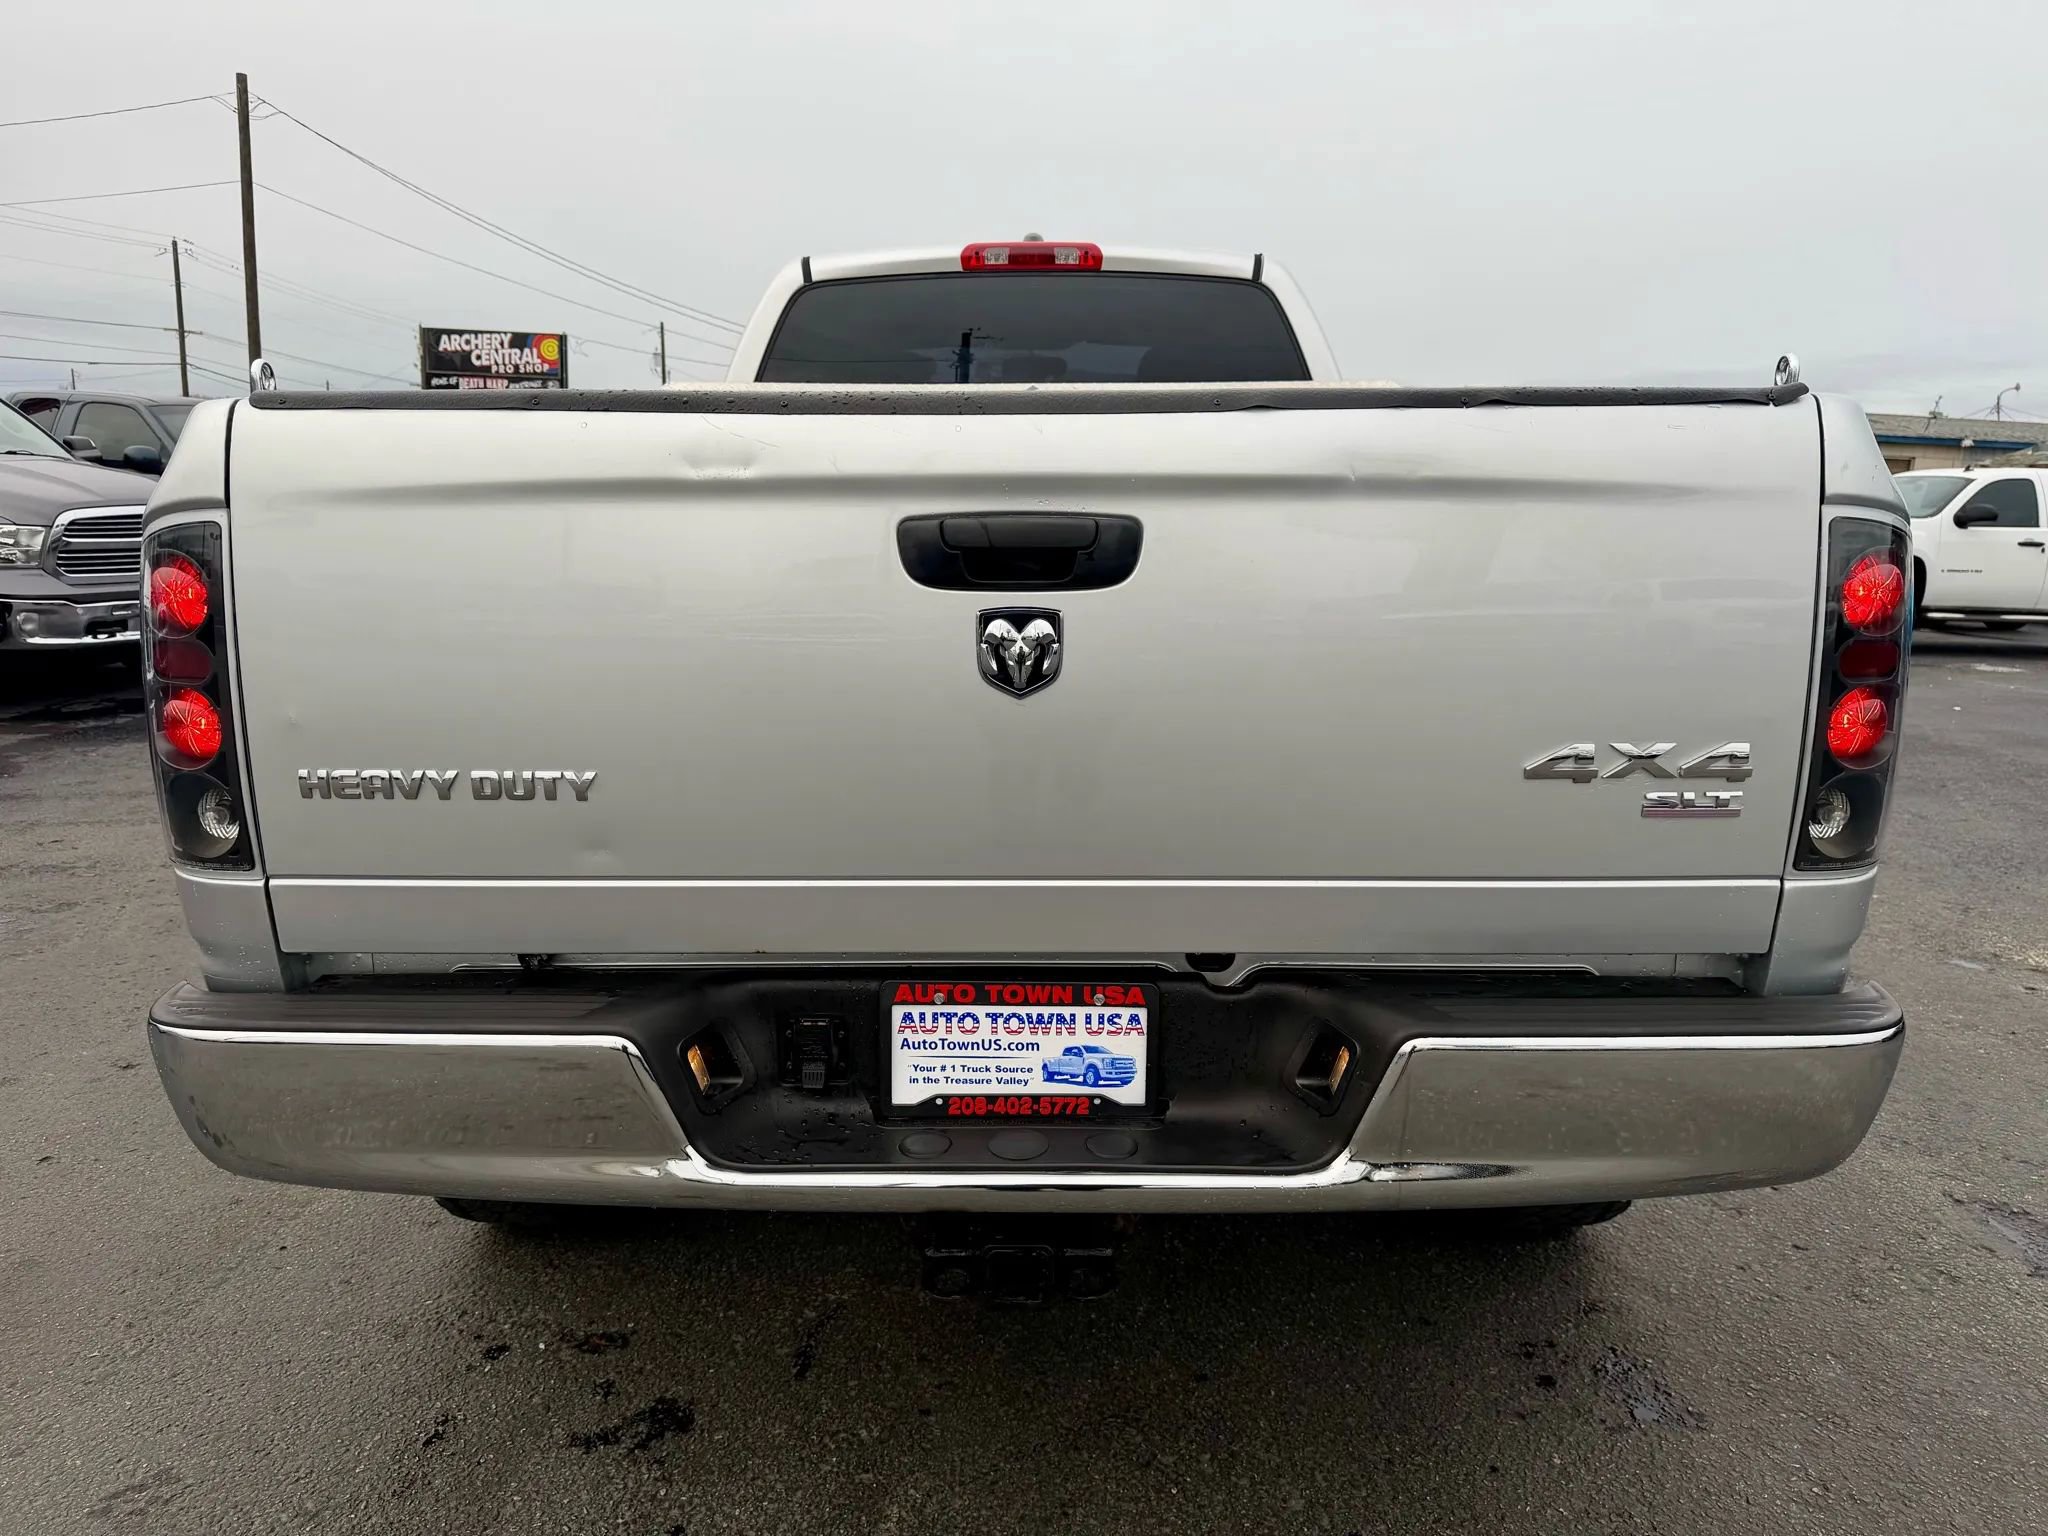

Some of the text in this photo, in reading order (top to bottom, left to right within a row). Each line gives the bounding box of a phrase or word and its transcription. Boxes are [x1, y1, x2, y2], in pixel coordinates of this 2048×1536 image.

[438, 333, 512, 351] ARCHERY
[471, 347, 541, 366] CENTRAL
[491, 363, 550, 374] PRO SHOP
[1523, 742, 1753, 783] 4X4
[298, 769, 597, 801] HEAVY DUTY
[1642, 791, 1743, 809] SLT
[894, 984, 1146, 1005] AUTO TOWN USA
[897, 1012, 1146, 1036] AUTO TOWN USA
[900, 1038, 1040, 1052] AutoTownUS.com
[950, 1065, 956, 1073] 1
[960, 1065, 992, 1073] Truck
[995, 1065, 1034, 1074] Source
[909, 1076, 919, 1084] in
[923, 1076, 941, 1085] the
[944, 1076, 992, 1085] Treasure
[948, 1097, 1090, 1115] 208-402-5772
